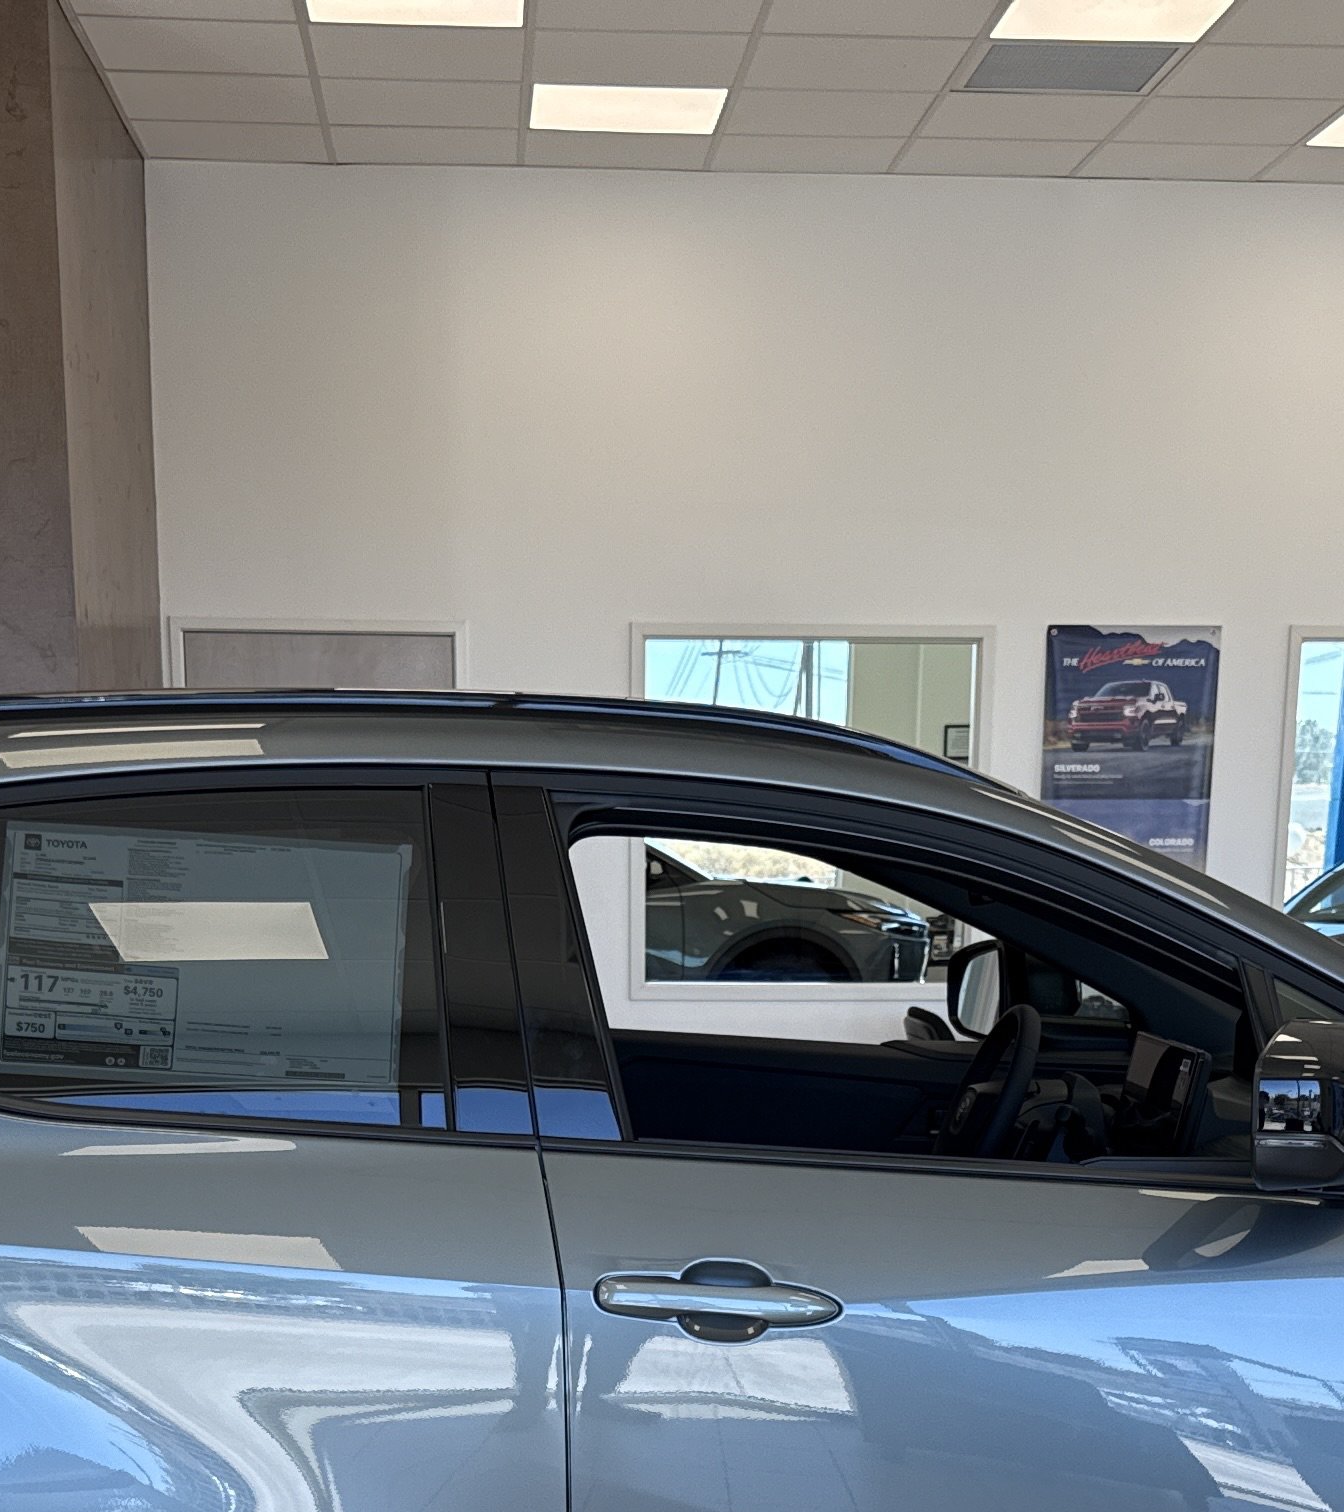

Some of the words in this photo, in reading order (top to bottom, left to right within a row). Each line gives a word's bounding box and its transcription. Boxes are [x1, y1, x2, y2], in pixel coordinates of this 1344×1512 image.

[1063, 658, 1079, 667] THE
[1079, 639, 1168, 673] Heartbeat
[1152, 658, 1164, 667] OF
[1164, 658, 1206, 667] AMERICA
[1054, 764, 1100, 773] SILVERADO
[46, 838, 88, 849] TOYOTA
[1149, 838, 1194, 846] COLORADO
[20, 973, 60, 992] 117
[123, 985, 164, 998] $4,750
[16, 1020, 45, 1034] $750
